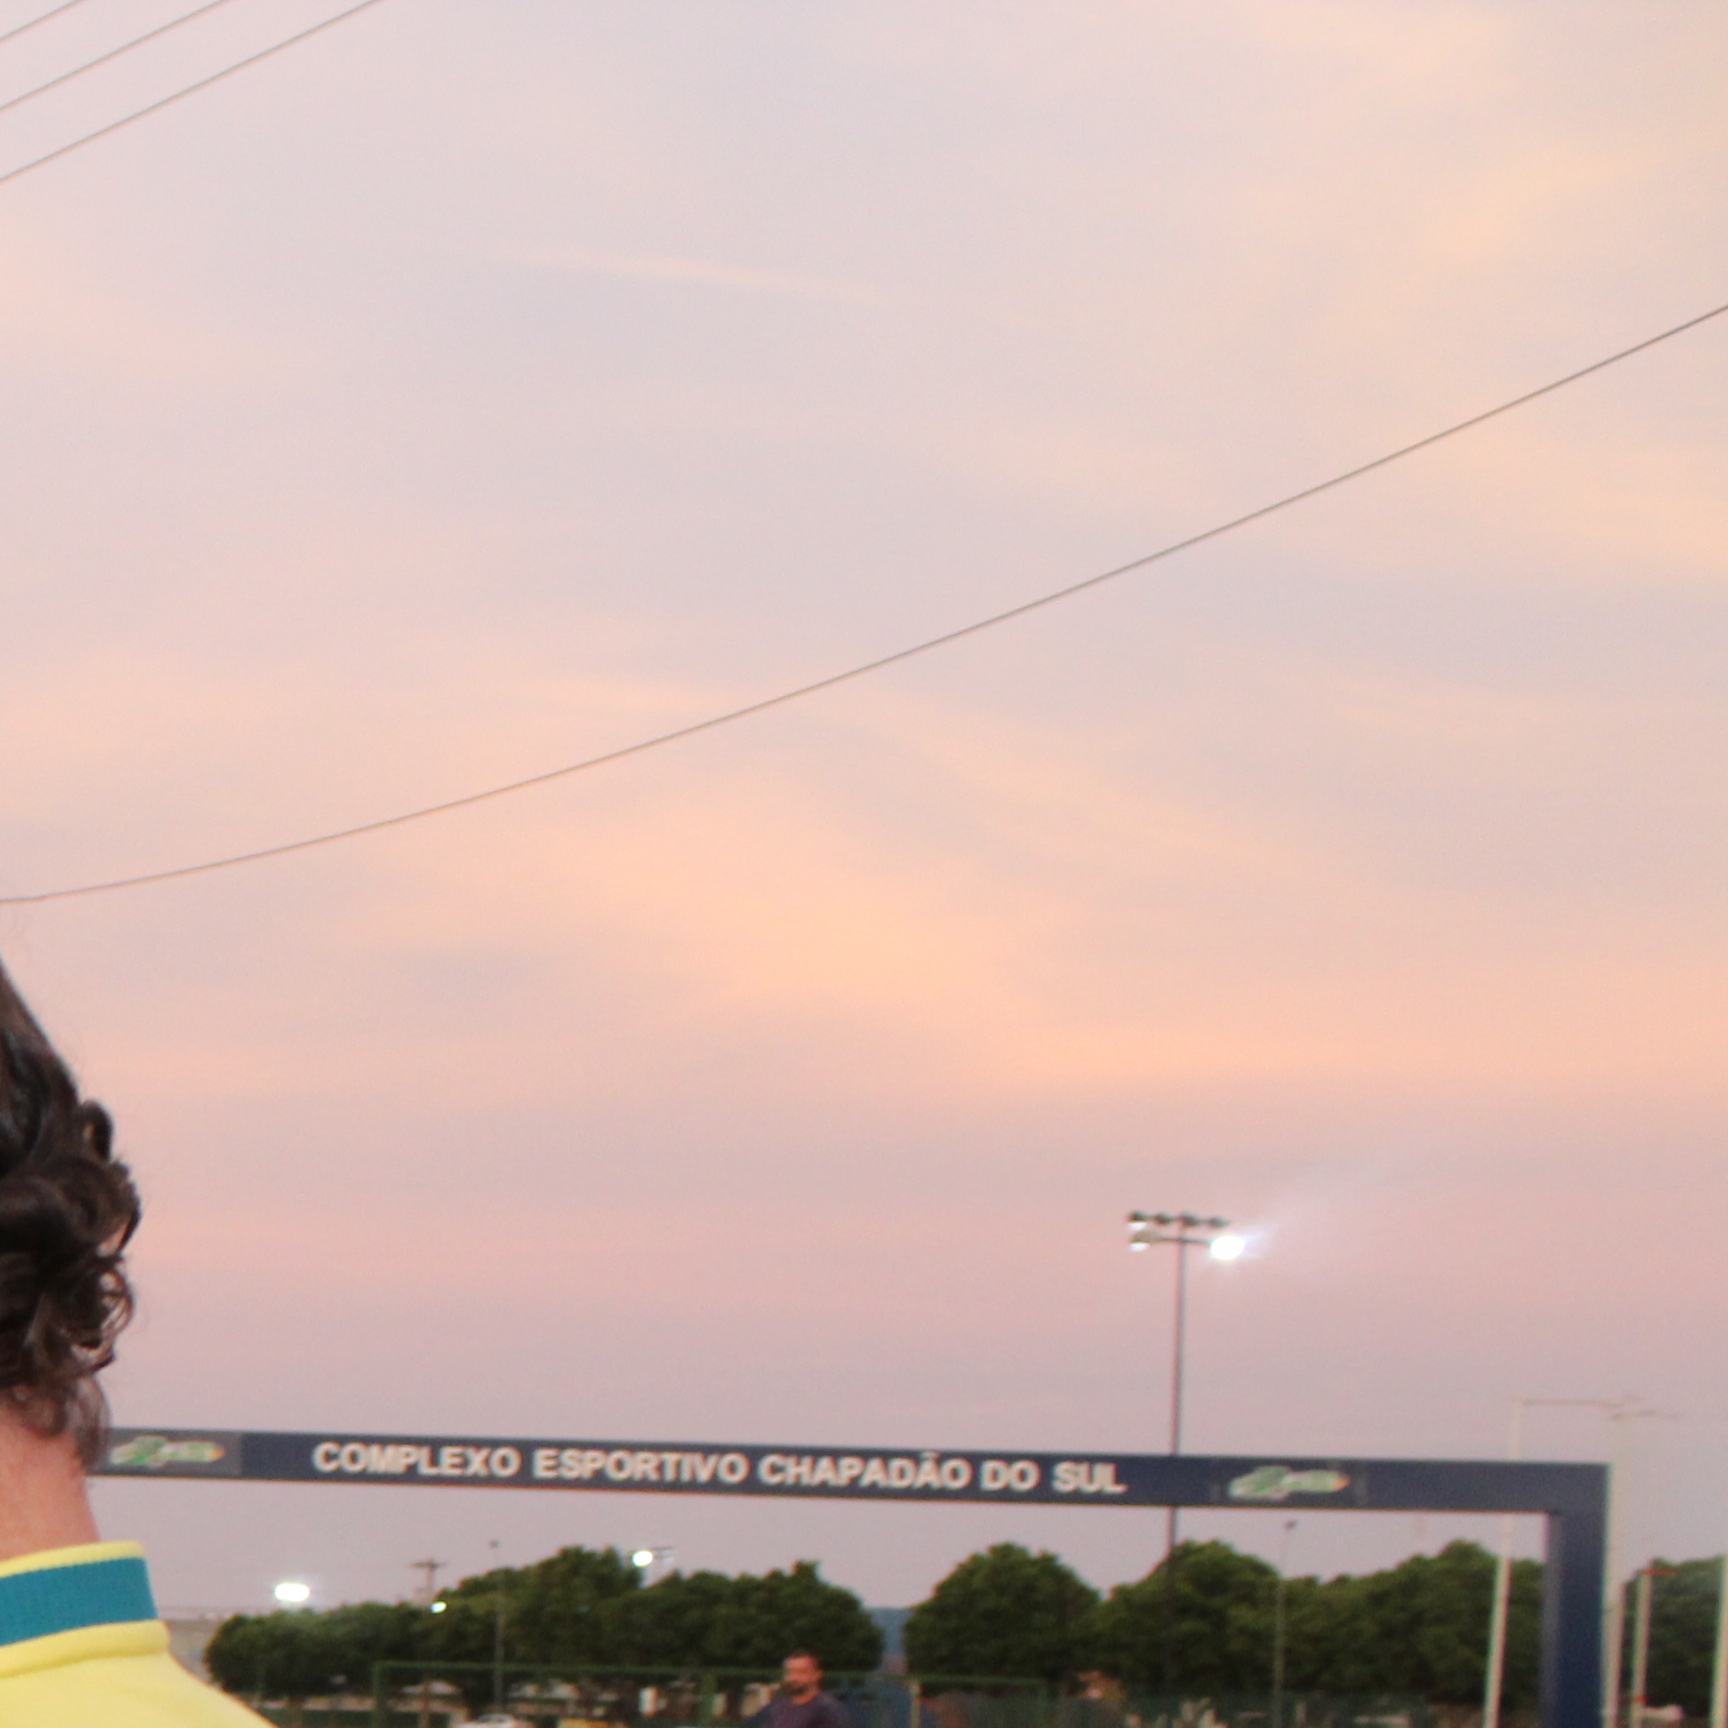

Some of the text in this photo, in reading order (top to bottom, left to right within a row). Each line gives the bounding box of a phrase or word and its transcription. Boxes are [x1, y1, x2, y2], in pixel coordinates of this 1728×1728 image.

[313, 1441, 1128, 1493] COMPLEXO ESPORTIVO CHAPADÃO DO SUL
